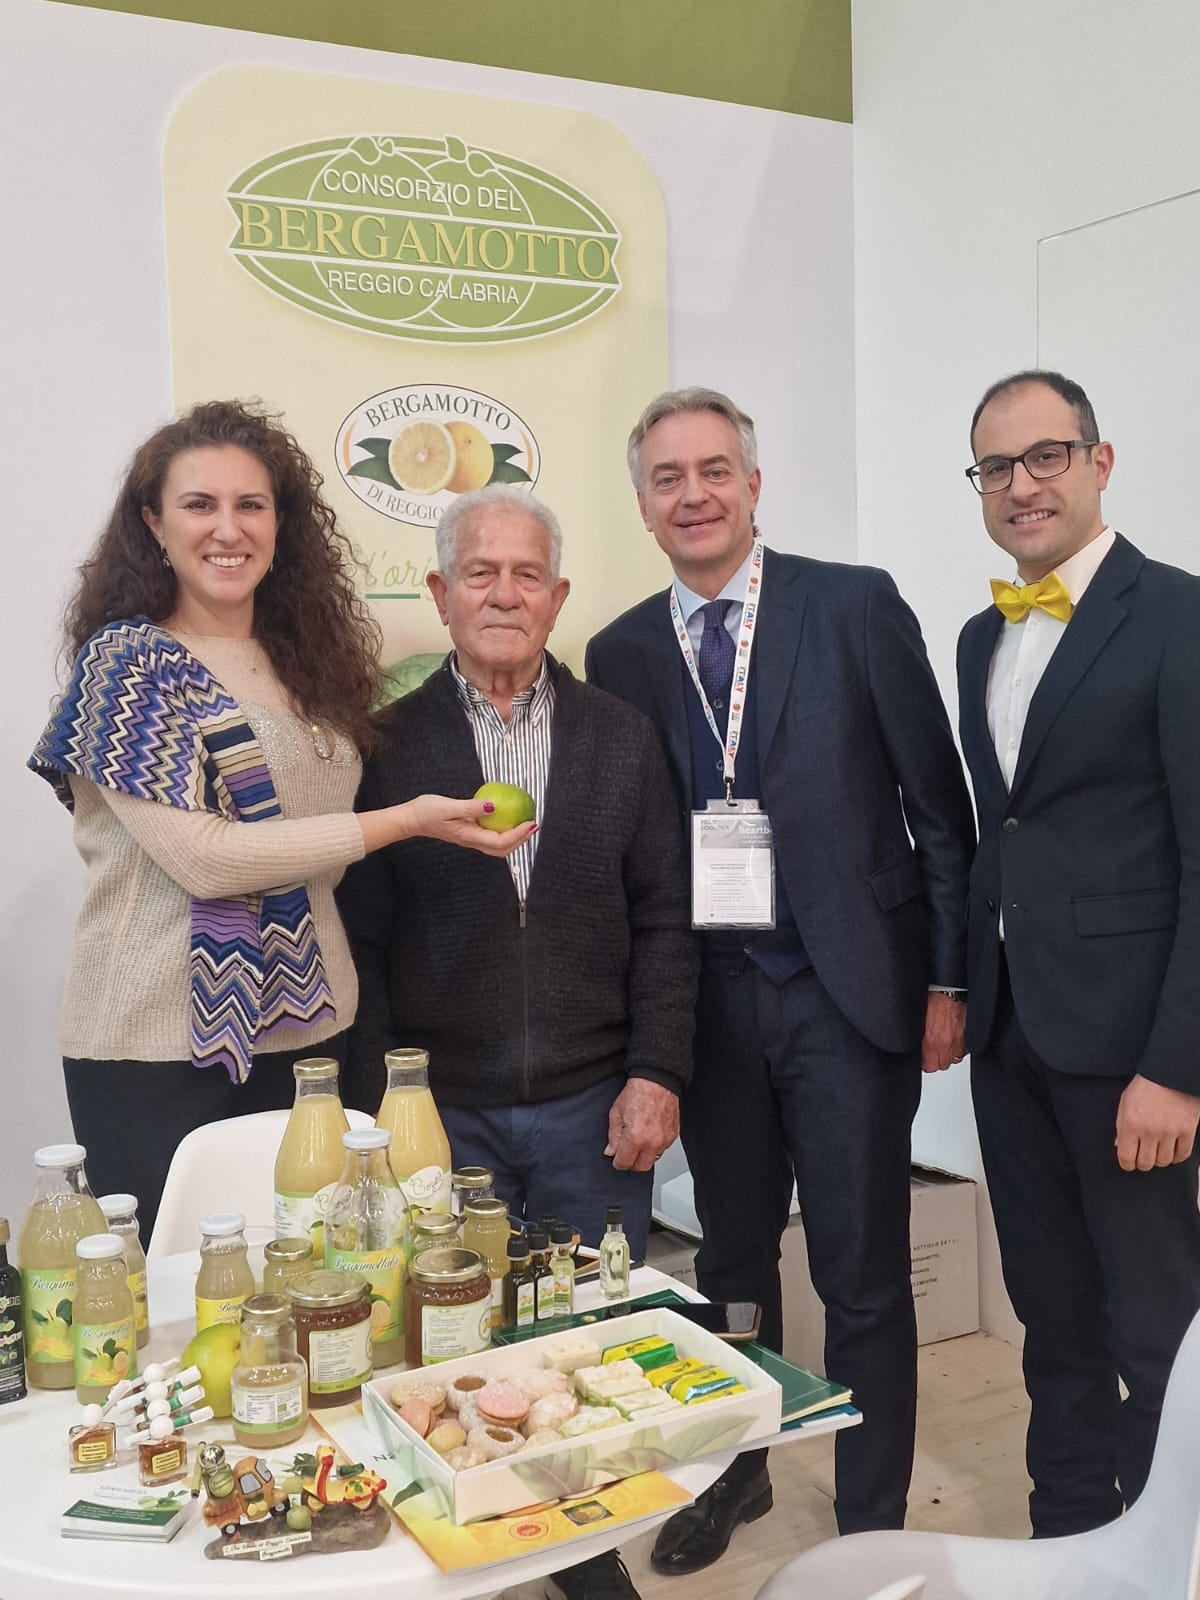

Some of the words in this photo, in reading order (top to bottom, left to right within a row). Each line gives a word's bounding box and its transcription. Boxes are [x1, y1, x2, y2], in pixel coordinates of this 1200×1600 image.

[322, 168, 471, 207] CONSORZIO
[477, 185, 522, 212] DEL
[238, 201, 611, 281] BERGAMOTTO
[326, 270, 414, 297] REGGIO
[418, 276, 520, 305] CALABRIA
[365, 392, 512, 431] BERGAMOTTO
[365, 484, 382, 502] DI
[363, 550, 434, 589] l'ori
[744, 603, 756, 630] ITALY
[735, 666, 746, 693] ITALY
[728, 730, 738, 759] ITALY
